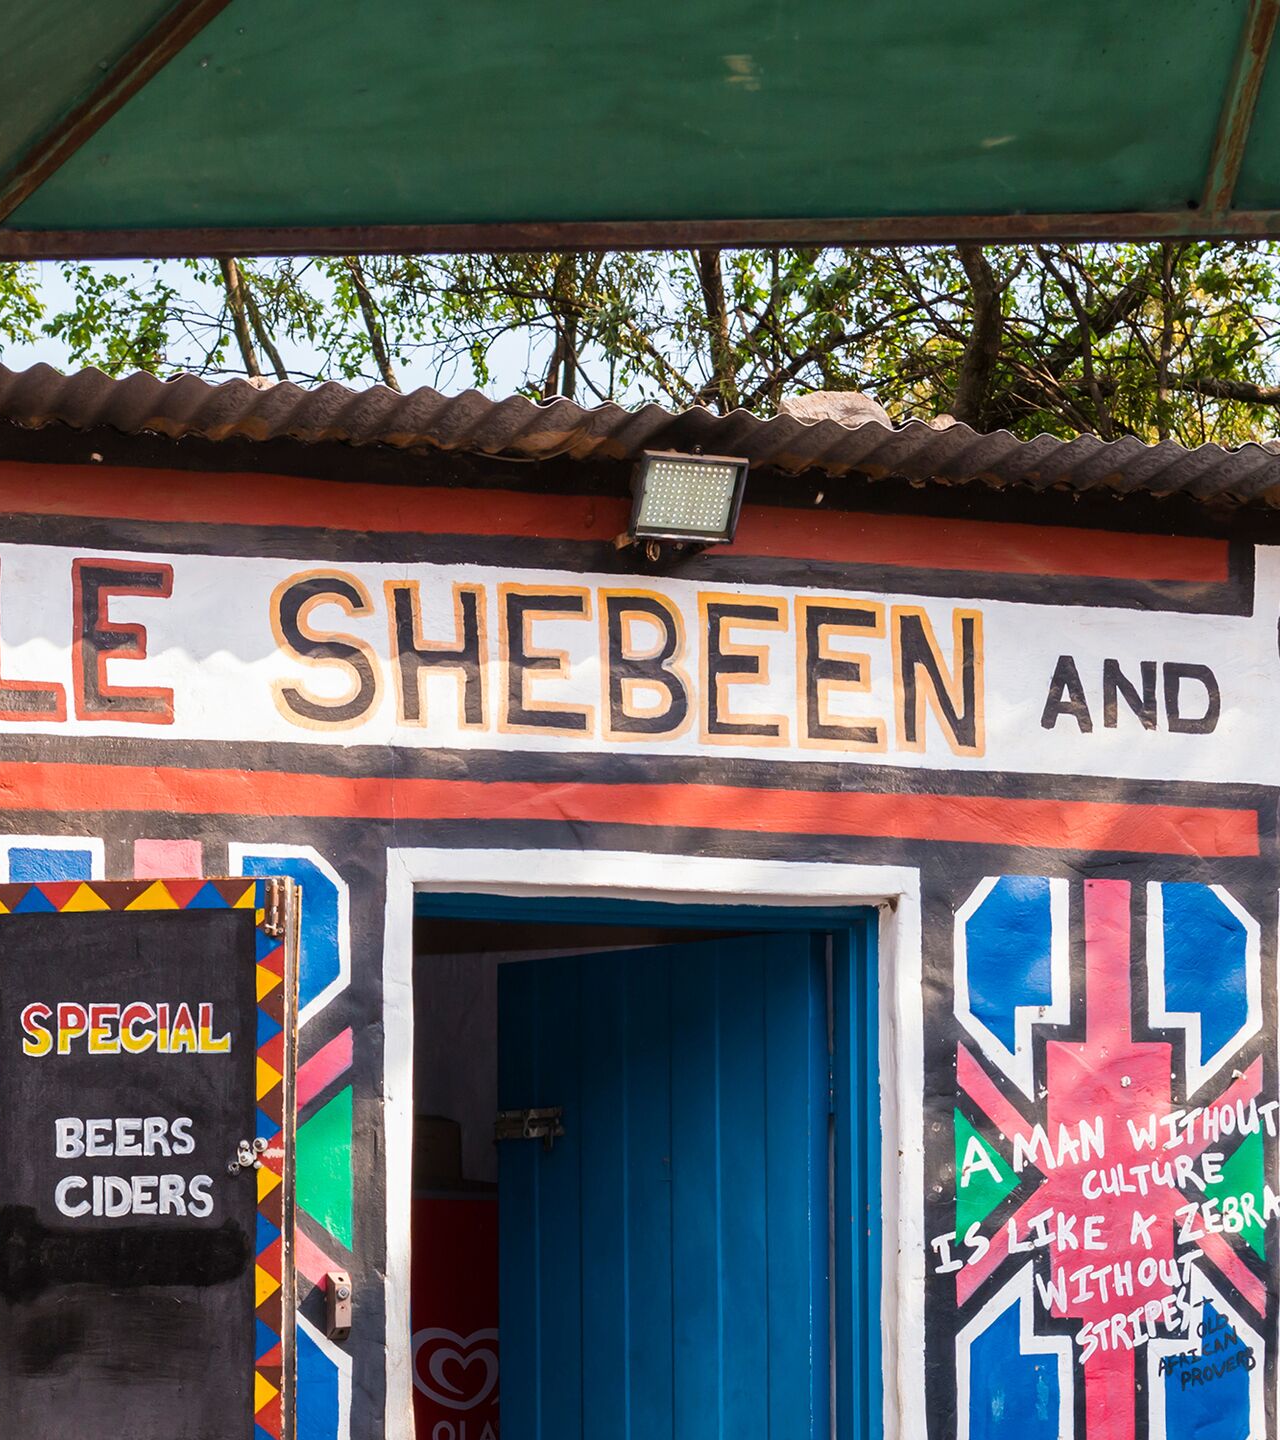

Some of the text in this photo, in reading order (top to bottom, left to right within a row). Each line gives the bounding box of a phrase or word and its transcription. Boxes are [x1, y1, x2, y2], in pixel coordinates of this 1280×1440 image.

[269, 569, 985, 758] SHEBEEN
[1040, 655, 1221, 734] AND
[20, 1002, 231, 1055] SPECIAL
[54, 1116, 195, 1159] BEERS
[961, 1099, 1279, 1187] A MAN WITHOUT
[54, 1174, 213, 1218] CIDERS
[1082, 1153, 1224, 1199] CULTURE
[931, 1222, 990, 1274] IS
[1008, 1208, 1107, 1255] LIKE
[1130, 1211, 1157, 1249] A
[1035, 1251, 1205, 1313] WITHOUT
[1075, 1287, 1191, 1365] STRIPES
